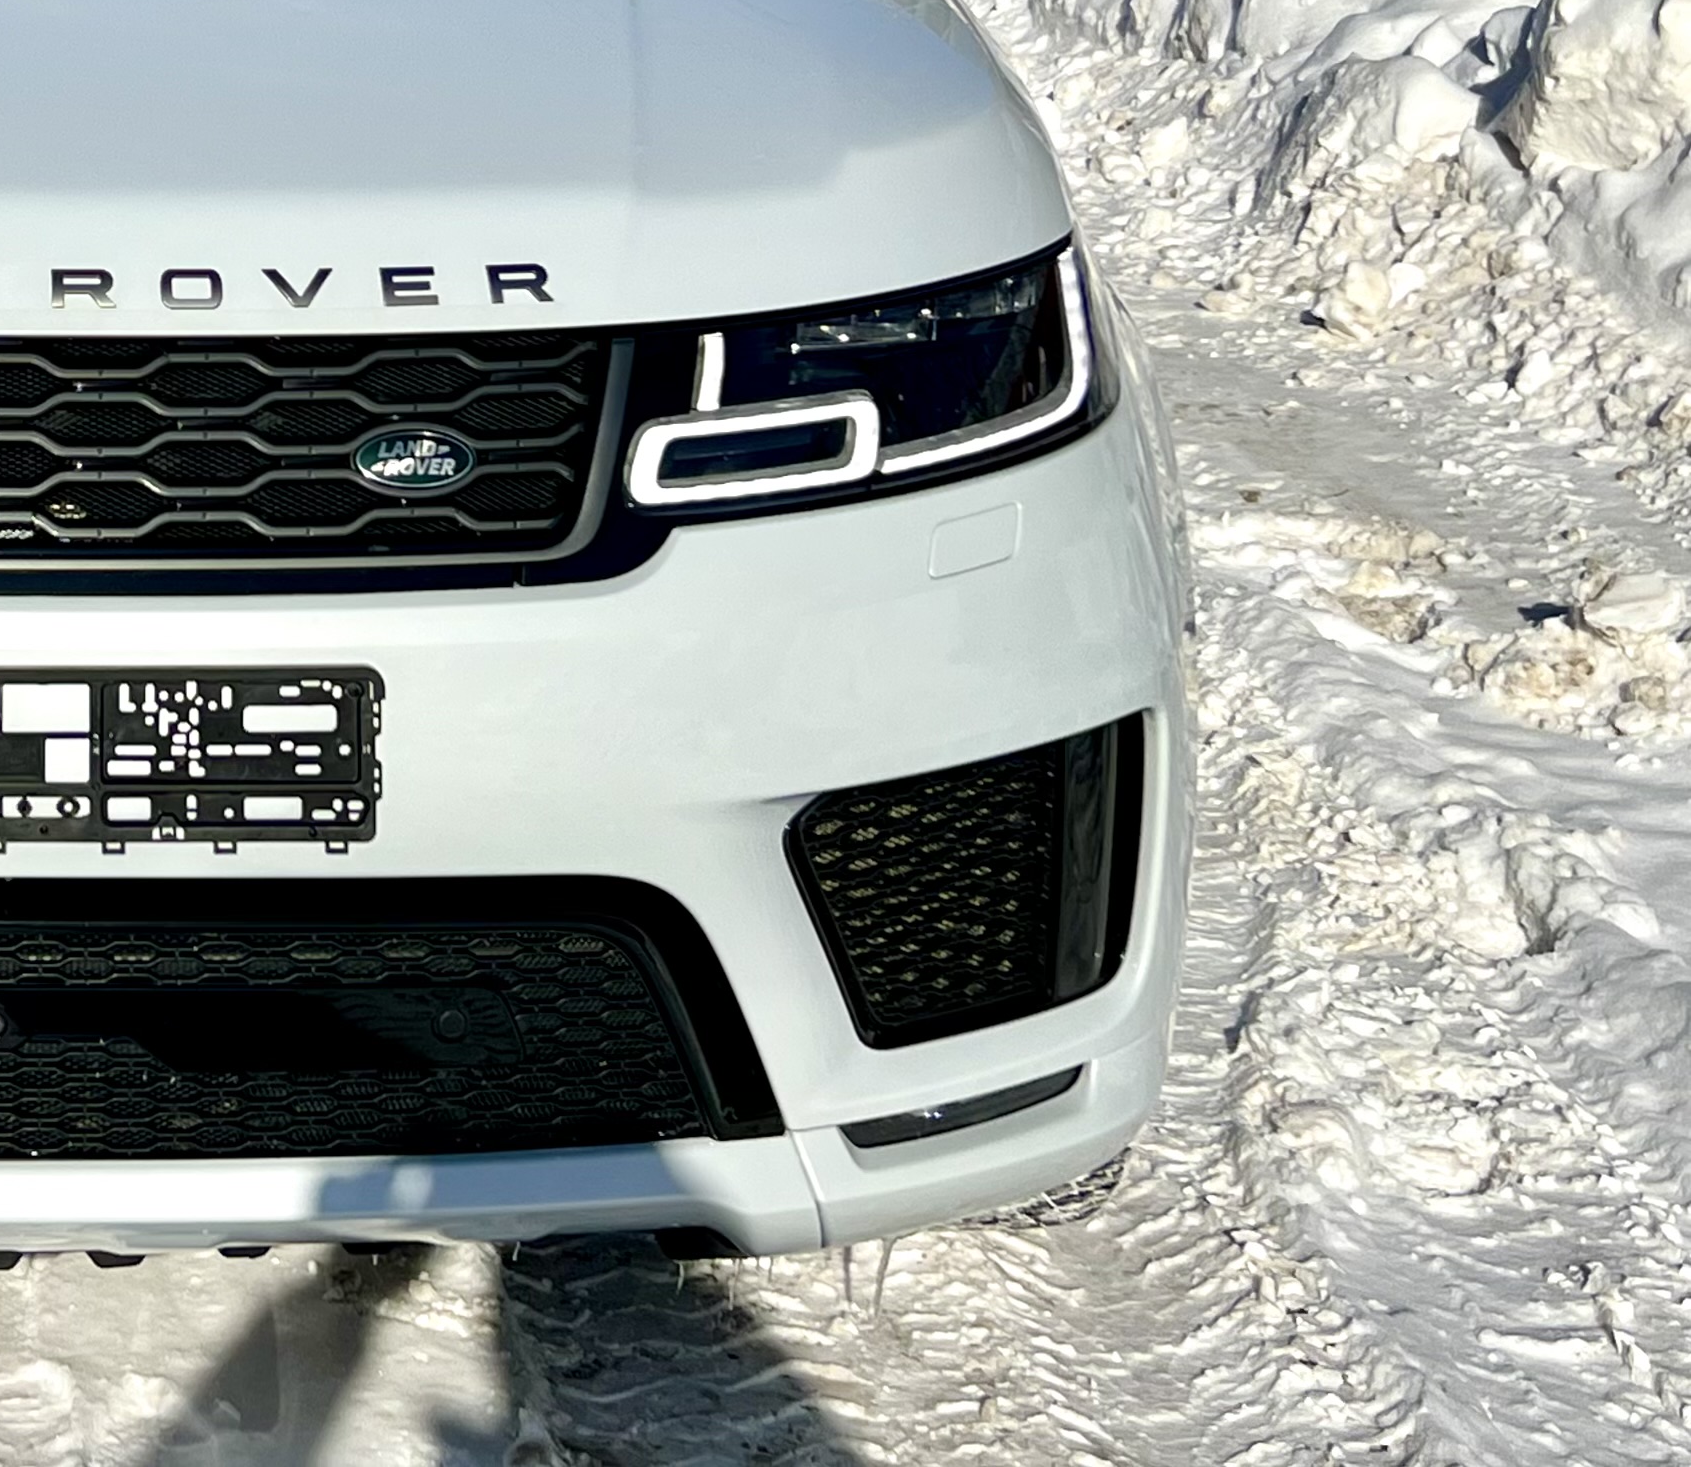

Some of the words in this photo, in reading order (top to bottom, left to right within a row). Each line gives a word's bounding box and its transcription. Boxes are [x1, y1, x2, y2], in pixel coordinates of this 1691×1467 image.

[50, 262, 555, 309] ROVER
[377, 439, 438, 458] LAND
[383, 457, 457, 476] ROVER
